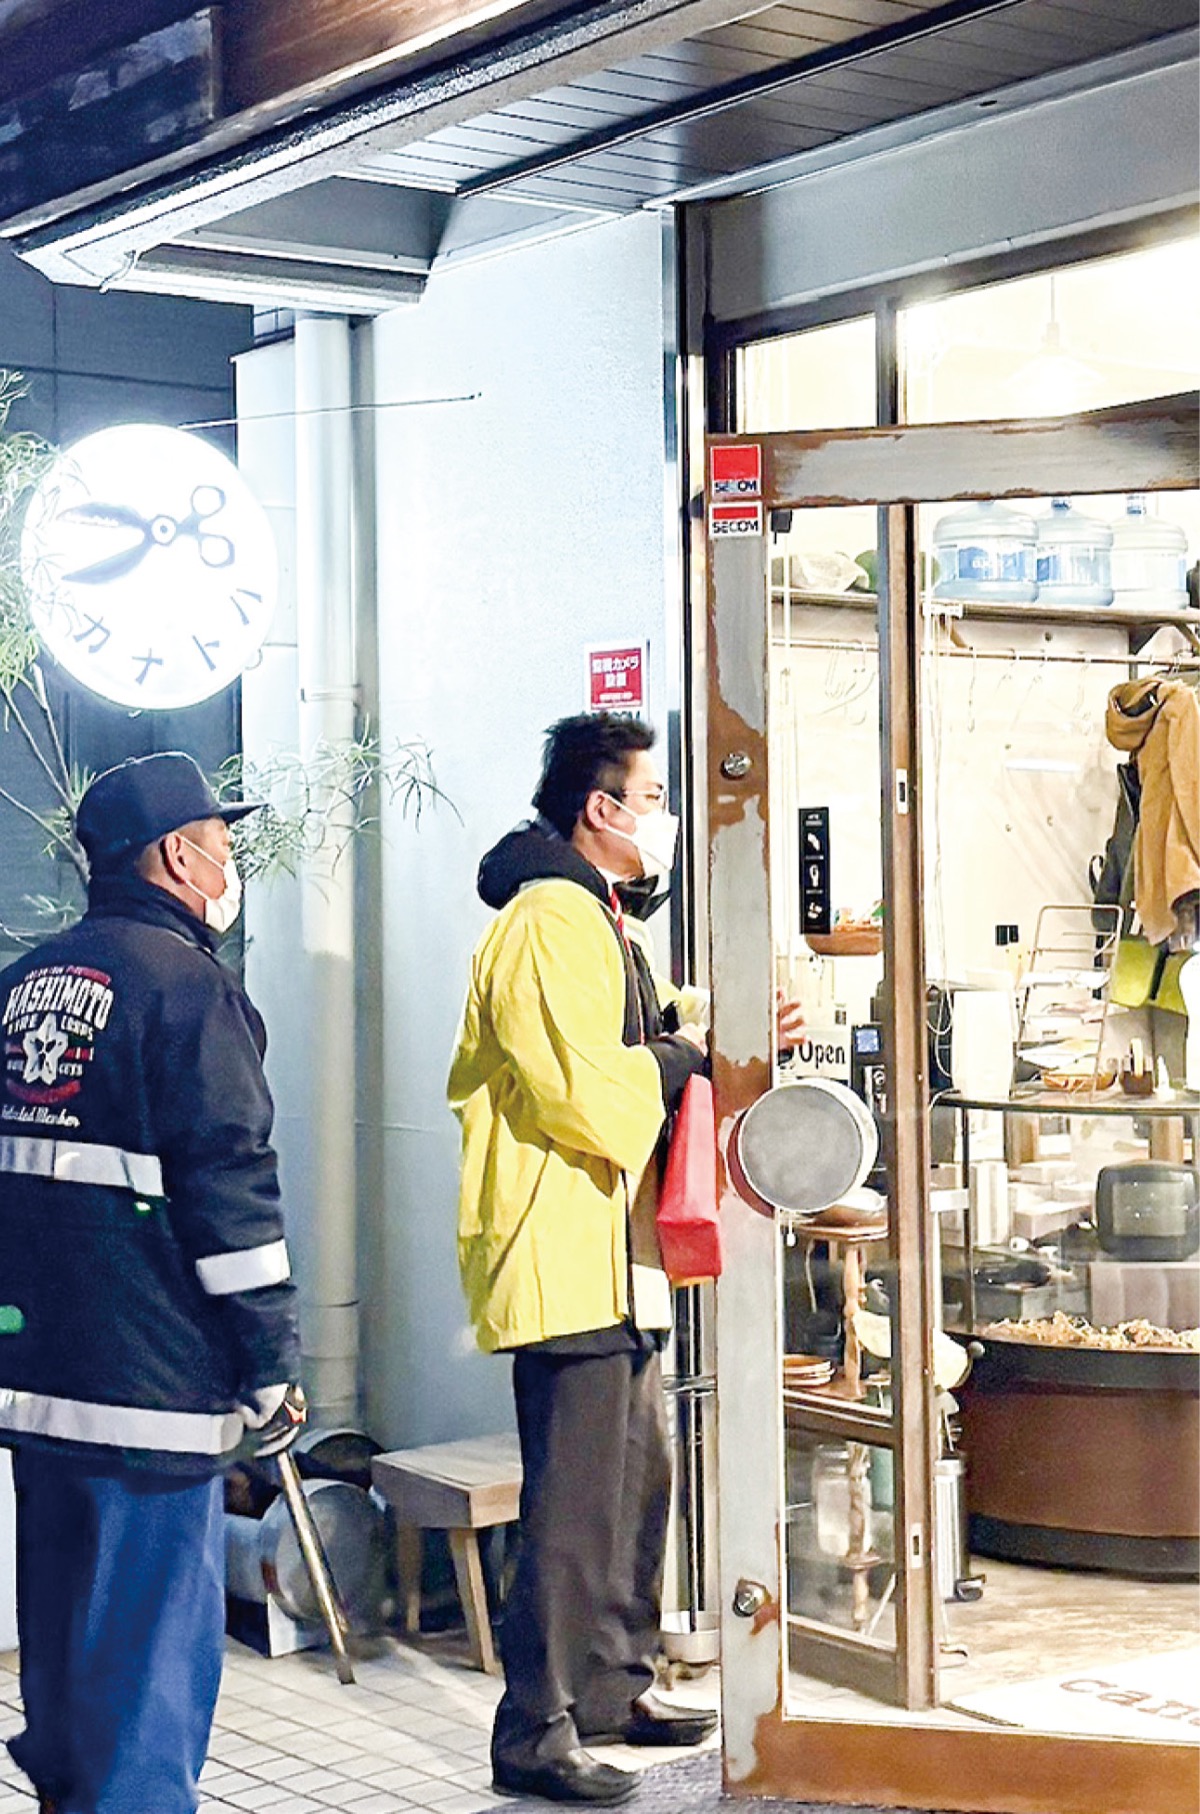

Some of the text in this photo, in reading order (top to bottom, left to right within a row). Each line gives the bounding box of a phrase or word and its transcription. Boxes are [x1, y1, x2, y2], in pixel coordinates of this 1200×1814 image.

[712, 520, 759, 534] SECOM
[591, 655, 639, 674] 監視カメラ
[605, 671, 627, 689] 設置
[2, 974, 114, 1030] HASHIMOTO
[798, 1040, 847, 1070] Open
